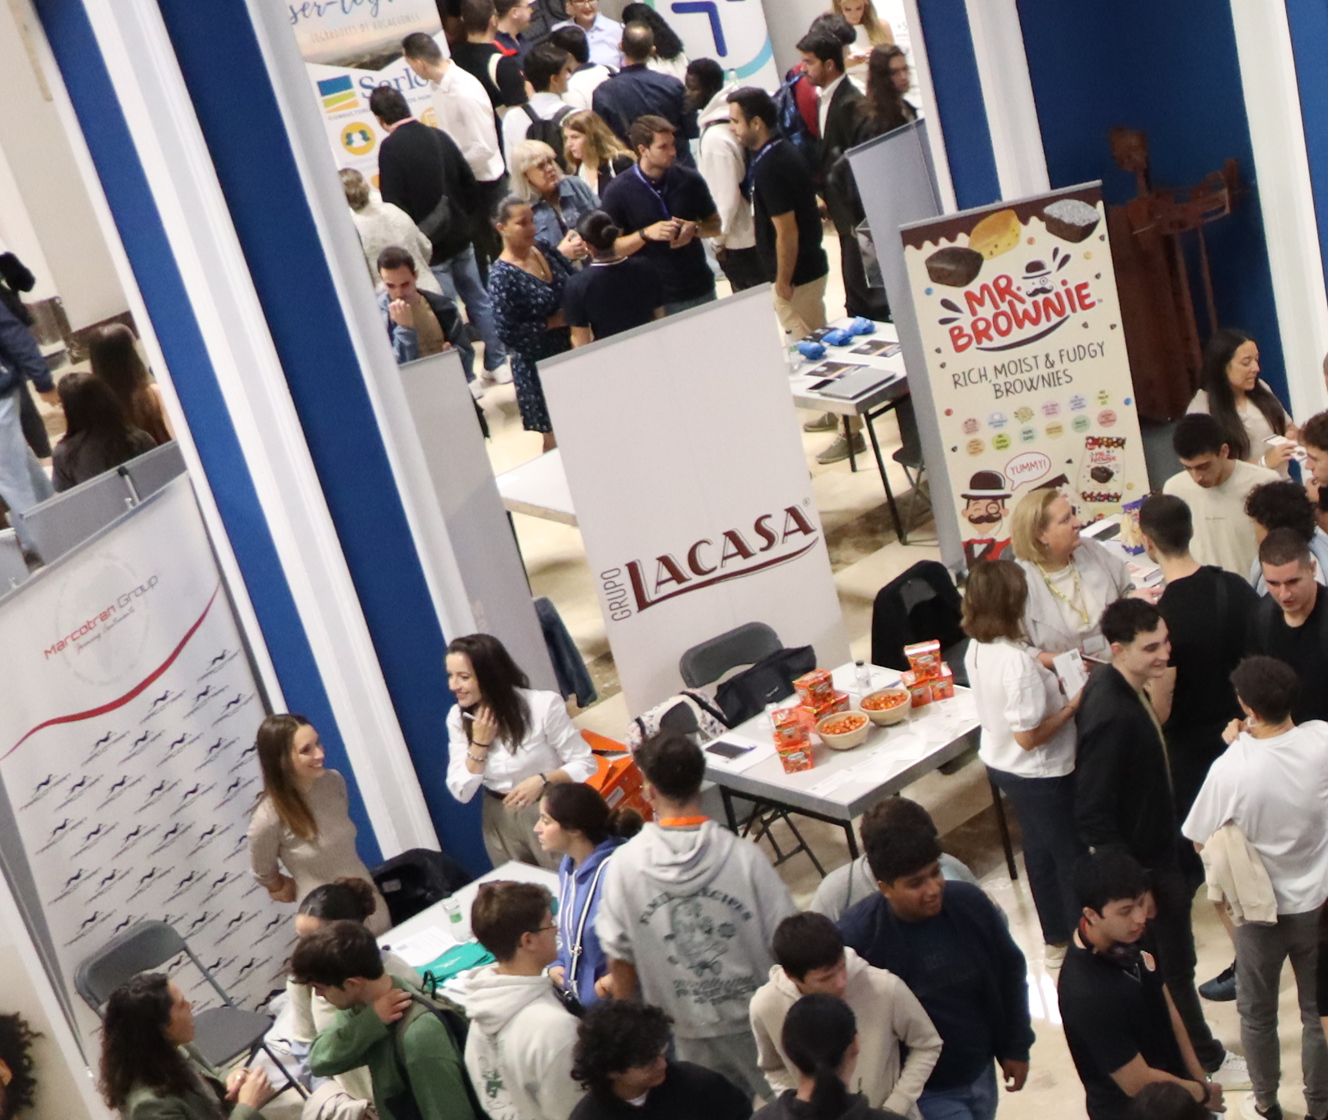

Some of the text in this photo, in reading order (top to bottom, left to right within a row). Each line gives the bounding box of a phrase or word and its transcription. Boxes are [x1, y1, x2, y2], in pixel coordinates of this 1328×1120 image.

[949, 279, 1097, 353] BROWNIE
[964, 274, 1026, 317] MR.
[952, 341, 1105, 389] RICH, MOIST & FUDGY
[993, 369, 1073, 399] BROWNIES
[1010, 459, 1047, 475] YUMMY!
[625, 504, 817, 613] LACASA
[44, 605, 115, 659] Marcotran
[117, 575, 159, 609] Group
[601, 567, 632, 621] GRUPO
